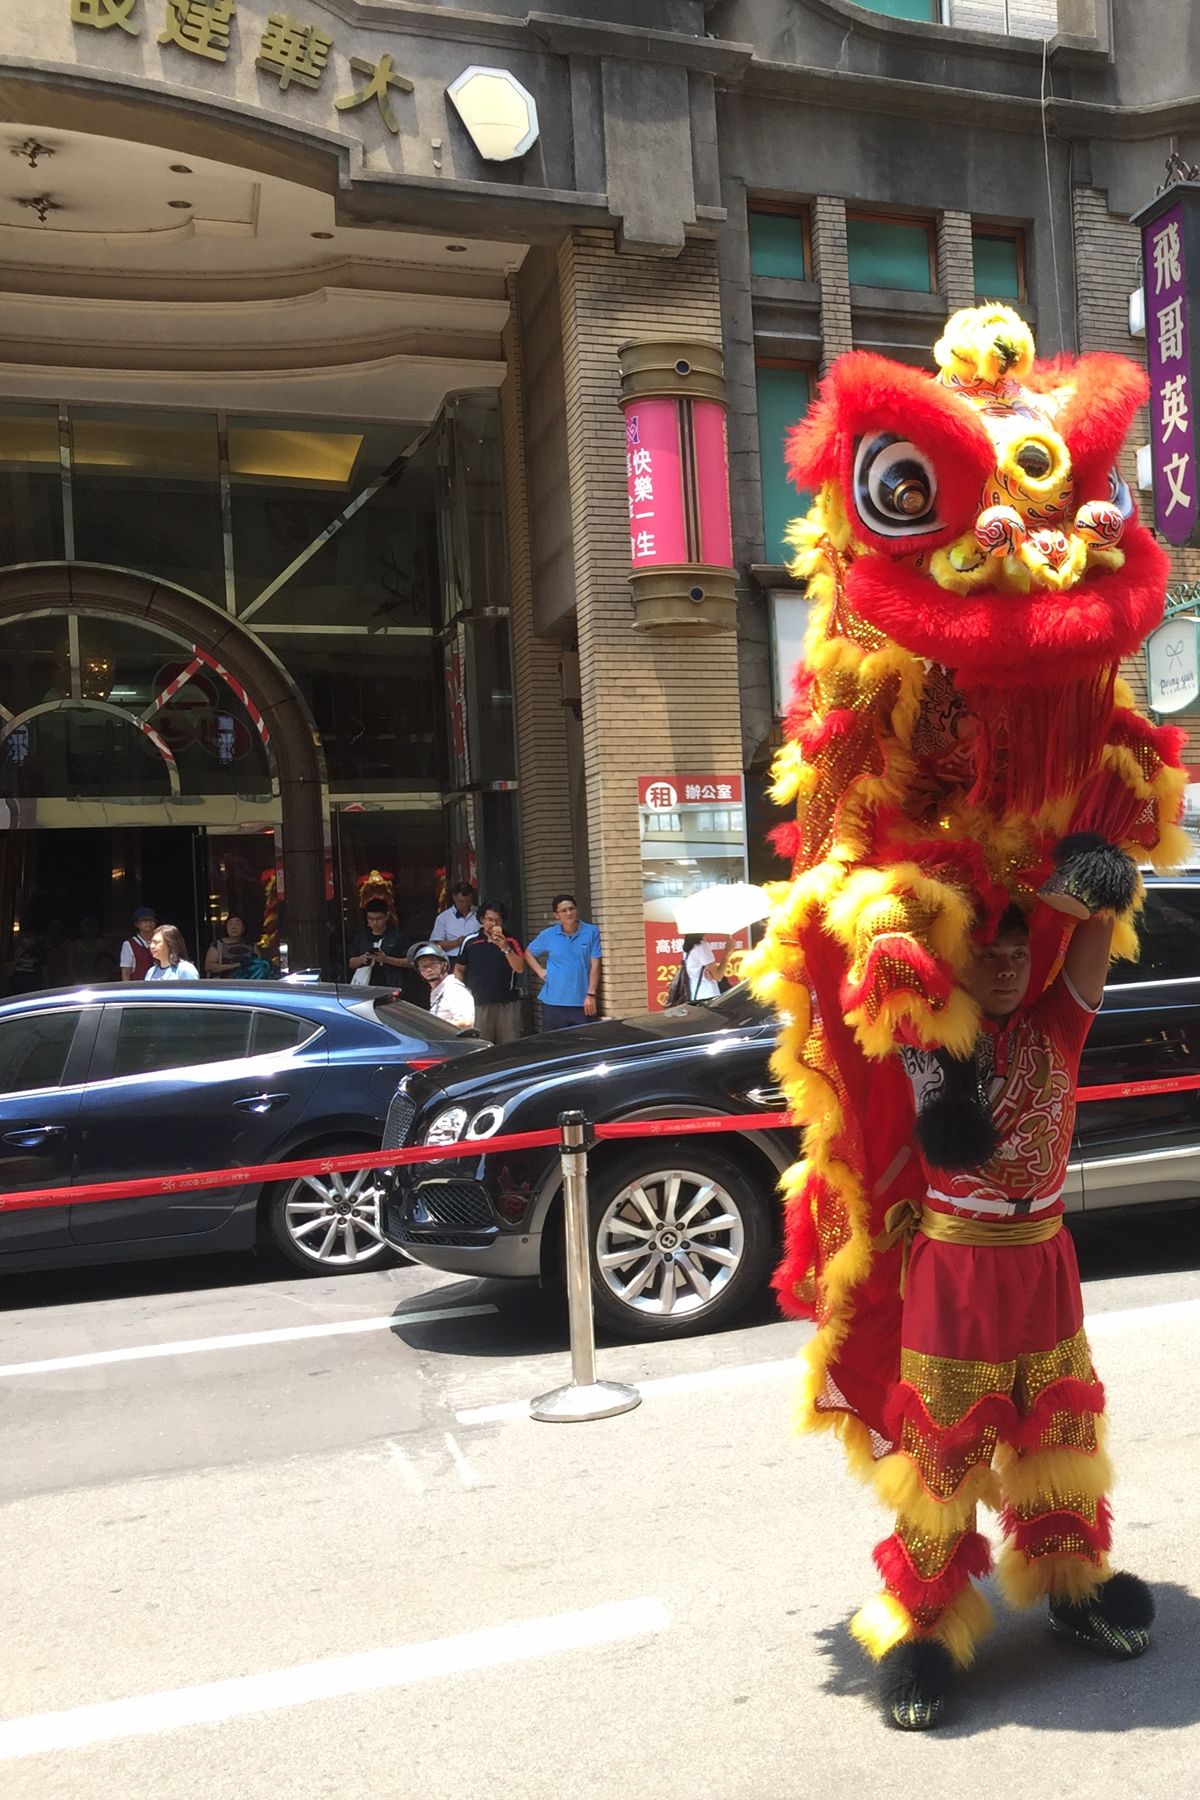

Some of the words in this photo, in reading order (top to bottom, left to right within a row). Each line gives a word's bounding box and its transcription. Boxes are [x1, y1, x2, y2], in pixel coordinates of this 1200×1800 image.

[1153, 222, 1191, 518] 飛哥英文
[632, 447, 657, 558] 快樂一生
[649, 786, 673, 808] 租
[684, 783, 733, 801] 辦公室
